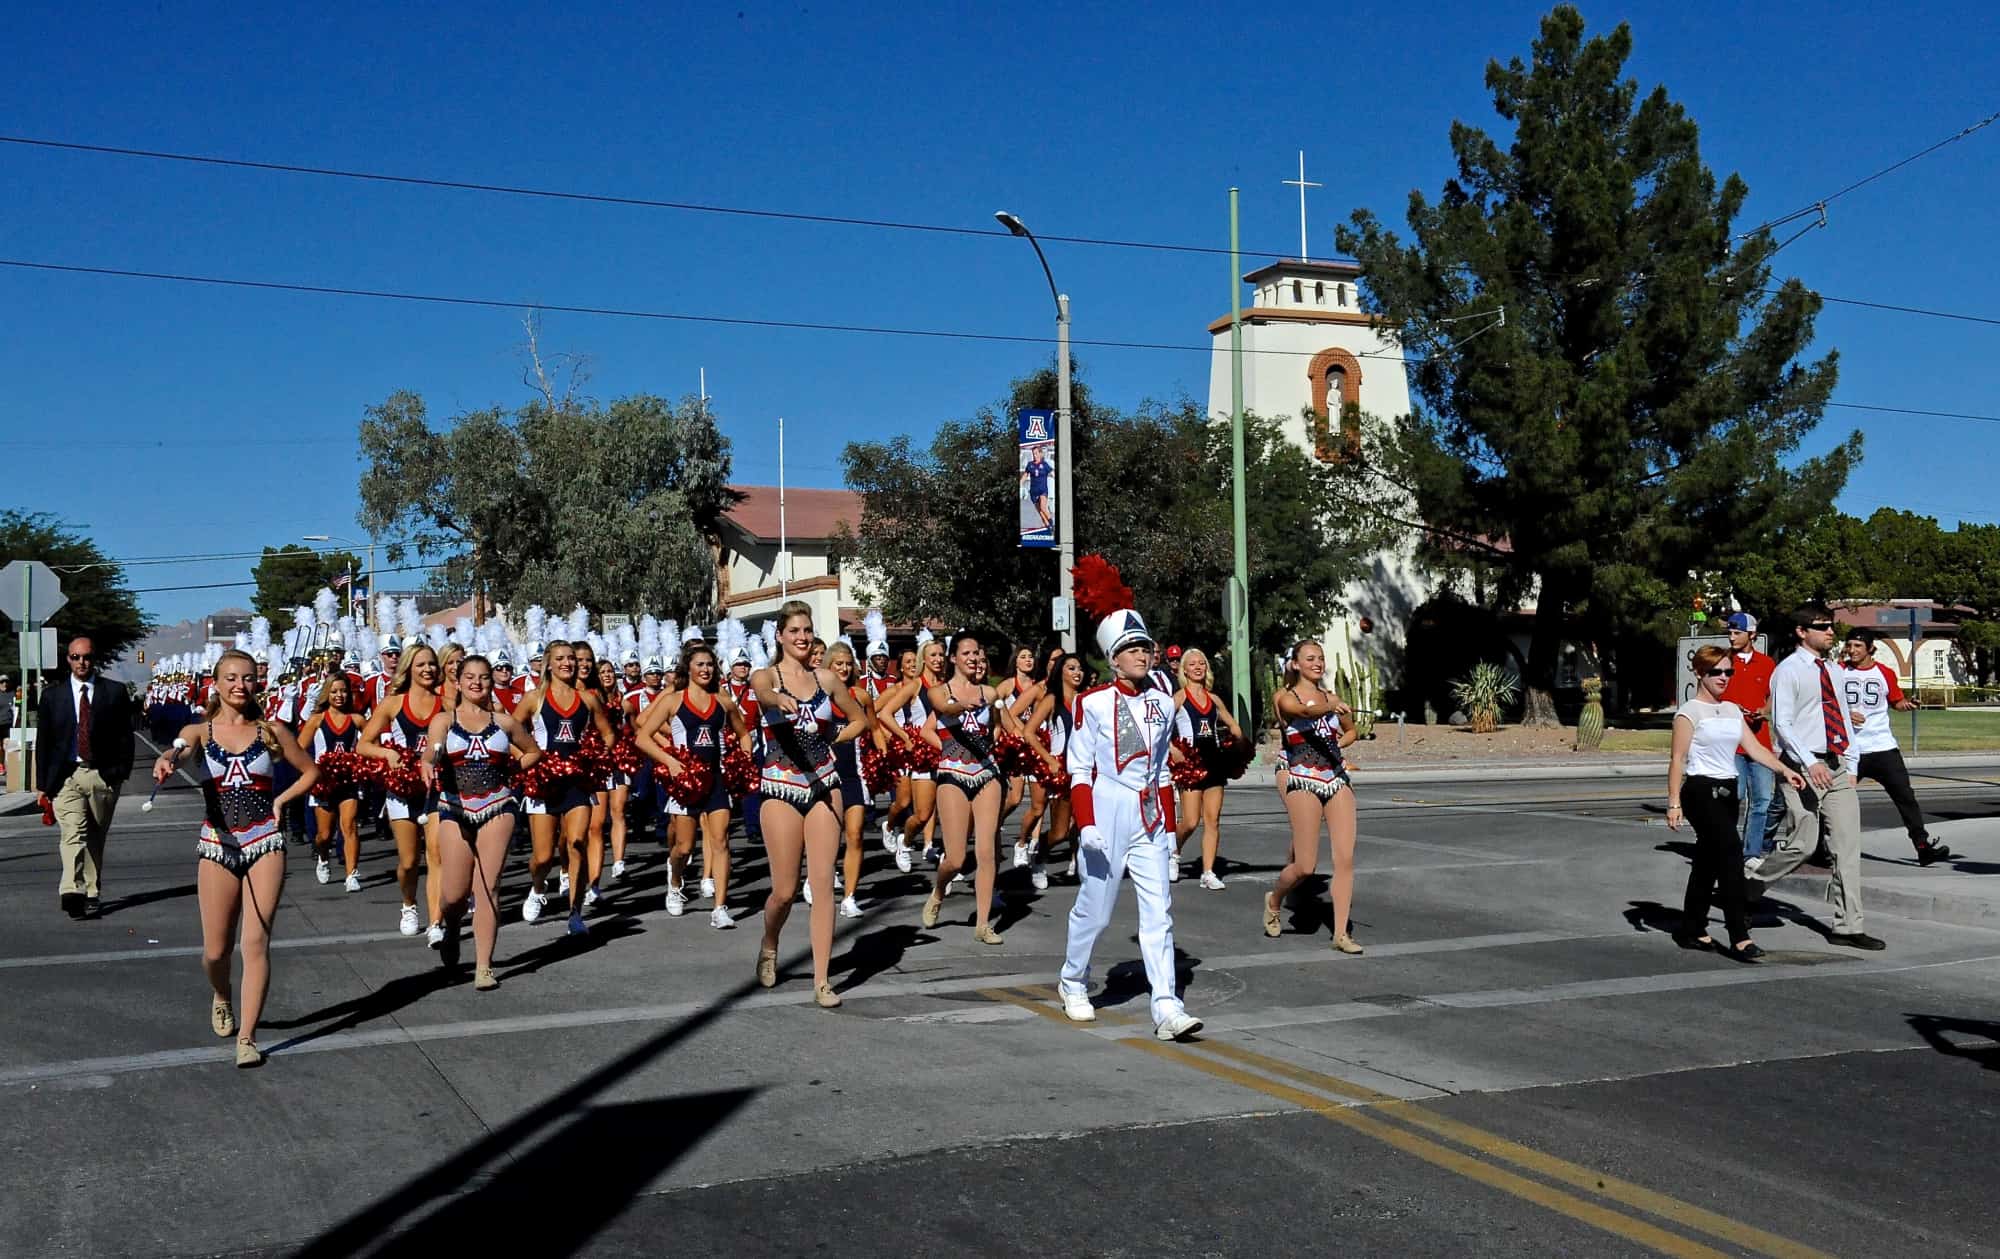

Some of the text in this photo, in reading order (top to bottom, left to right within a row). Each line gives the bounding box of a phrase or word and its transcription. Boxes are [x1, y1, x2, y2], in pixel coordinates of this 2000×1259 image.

[1026, 416, 1048, 440] A
[794, 703, 816, 730] A
[962, 710, 981, 733] A
[1144, 699, 1167, 725] A
[554, 719, 575, 743] A
[693, 724, 715, 747] A
[1198, 719, 1212, 737] A
[1315, 715, 1332, 738] A
[464, 735, 490, 761] A
[221, 756, 253, 788] A
